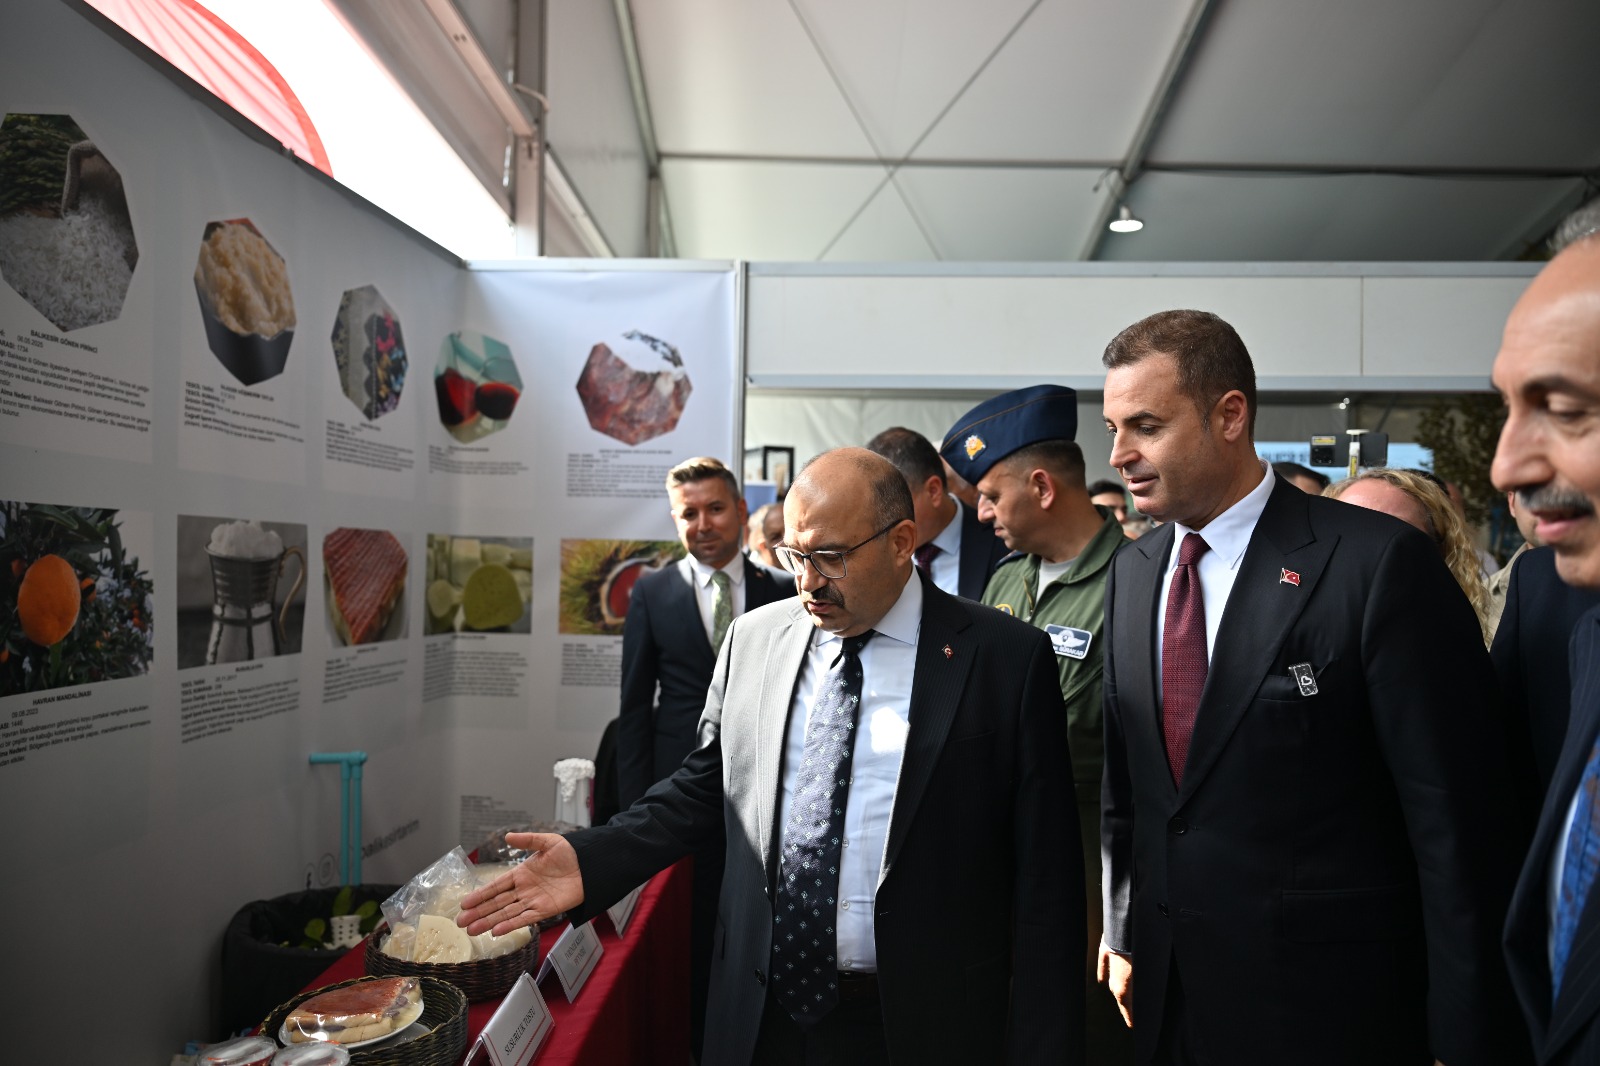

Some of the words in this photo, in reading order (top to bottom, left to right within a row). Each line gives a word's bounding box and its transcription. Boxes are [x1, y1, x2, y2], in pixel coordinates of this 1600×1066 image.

[31, 329, 59, 343] BALIKESİR
[32, 696, 55, 706] HAVRAN
[56, 690, 92, 702] MANDALİNASI
[504, 1022, 526, 1056] SUSURLUK
